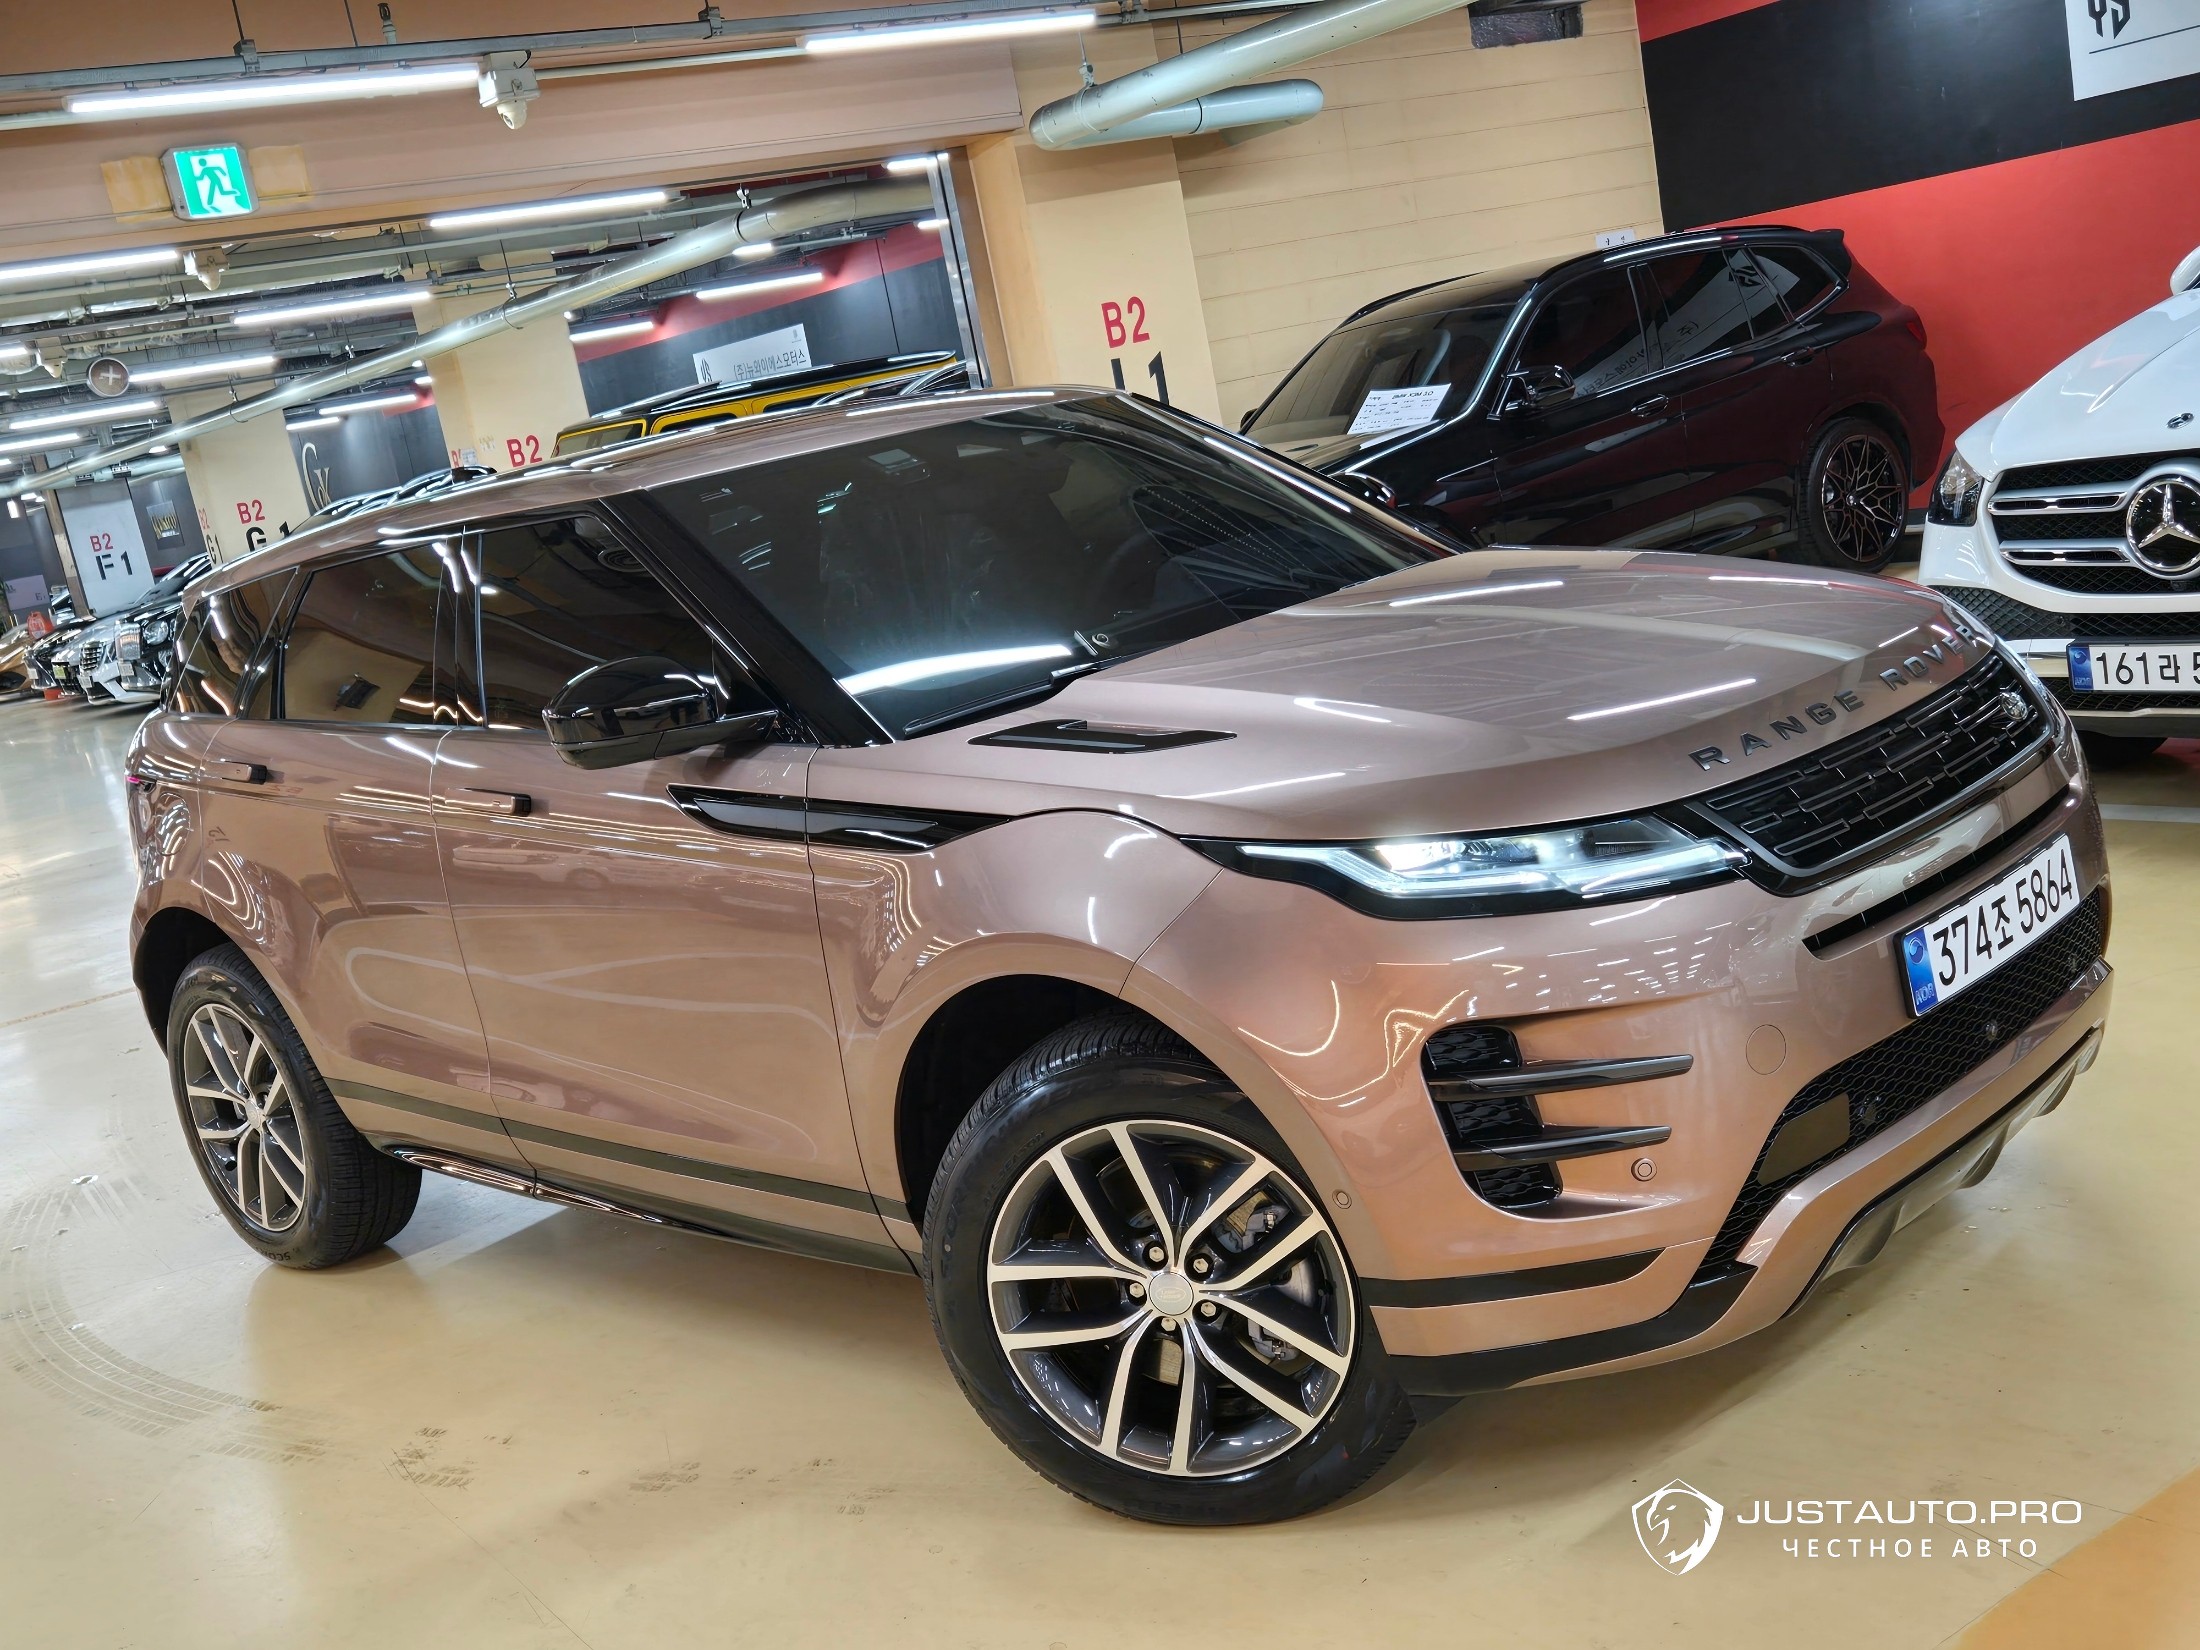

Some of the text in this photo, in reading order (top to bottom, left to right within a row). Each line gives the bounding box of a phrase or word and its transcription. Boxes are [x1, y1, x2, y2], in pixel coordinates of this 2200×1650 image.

[1101, 296, 1150, 348] B2
[506, 435, 542, 467] B2
[237, 500, 265, 524] B2
[90, 533, 114, 552] B2
[2096, 652, 2181, 685] 161라
[1689, 624, 1978, 771] RANGE ROVER
[1933, 849, 2073, 986] 374조 5864
